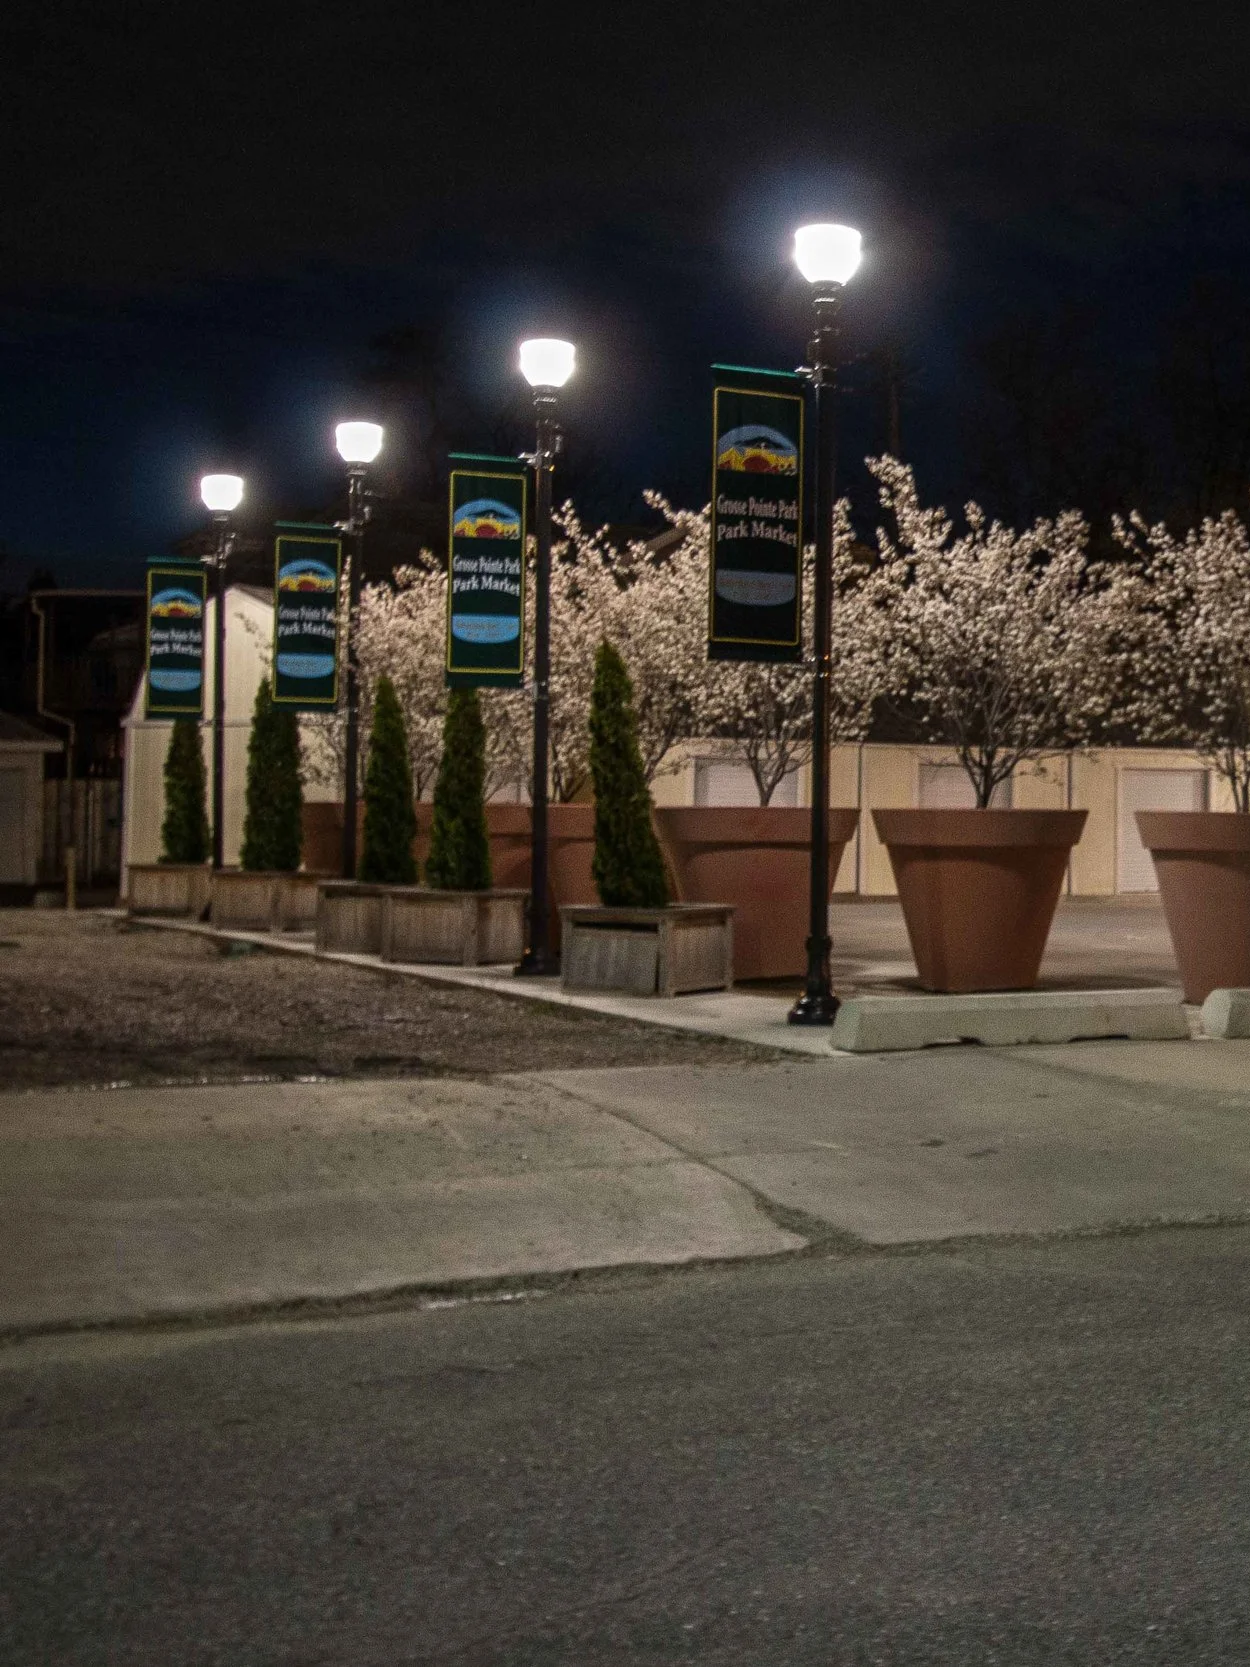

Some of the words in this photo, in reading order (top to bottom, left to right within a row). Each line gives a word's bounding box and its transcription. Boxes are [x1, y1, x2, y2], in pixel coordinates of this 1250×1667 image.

[717, 494, 747, 516] Grosse
[748, 496, 777, 518] Pointe
[778, 500, 799, 520] Park
[717, 520, 748, 542] Park
[751, 520, 798, 548] Market
[453, 554, 479, 573] Grosse
[479, 556, 503, 574] Pointe
[504, 557, 521, 575] Park
[453, 575, 479, 594] Park
[481, 575, 520, 597] Market
[278, 621, 300, 637] Park
[302, 621, 336, 639] Market
